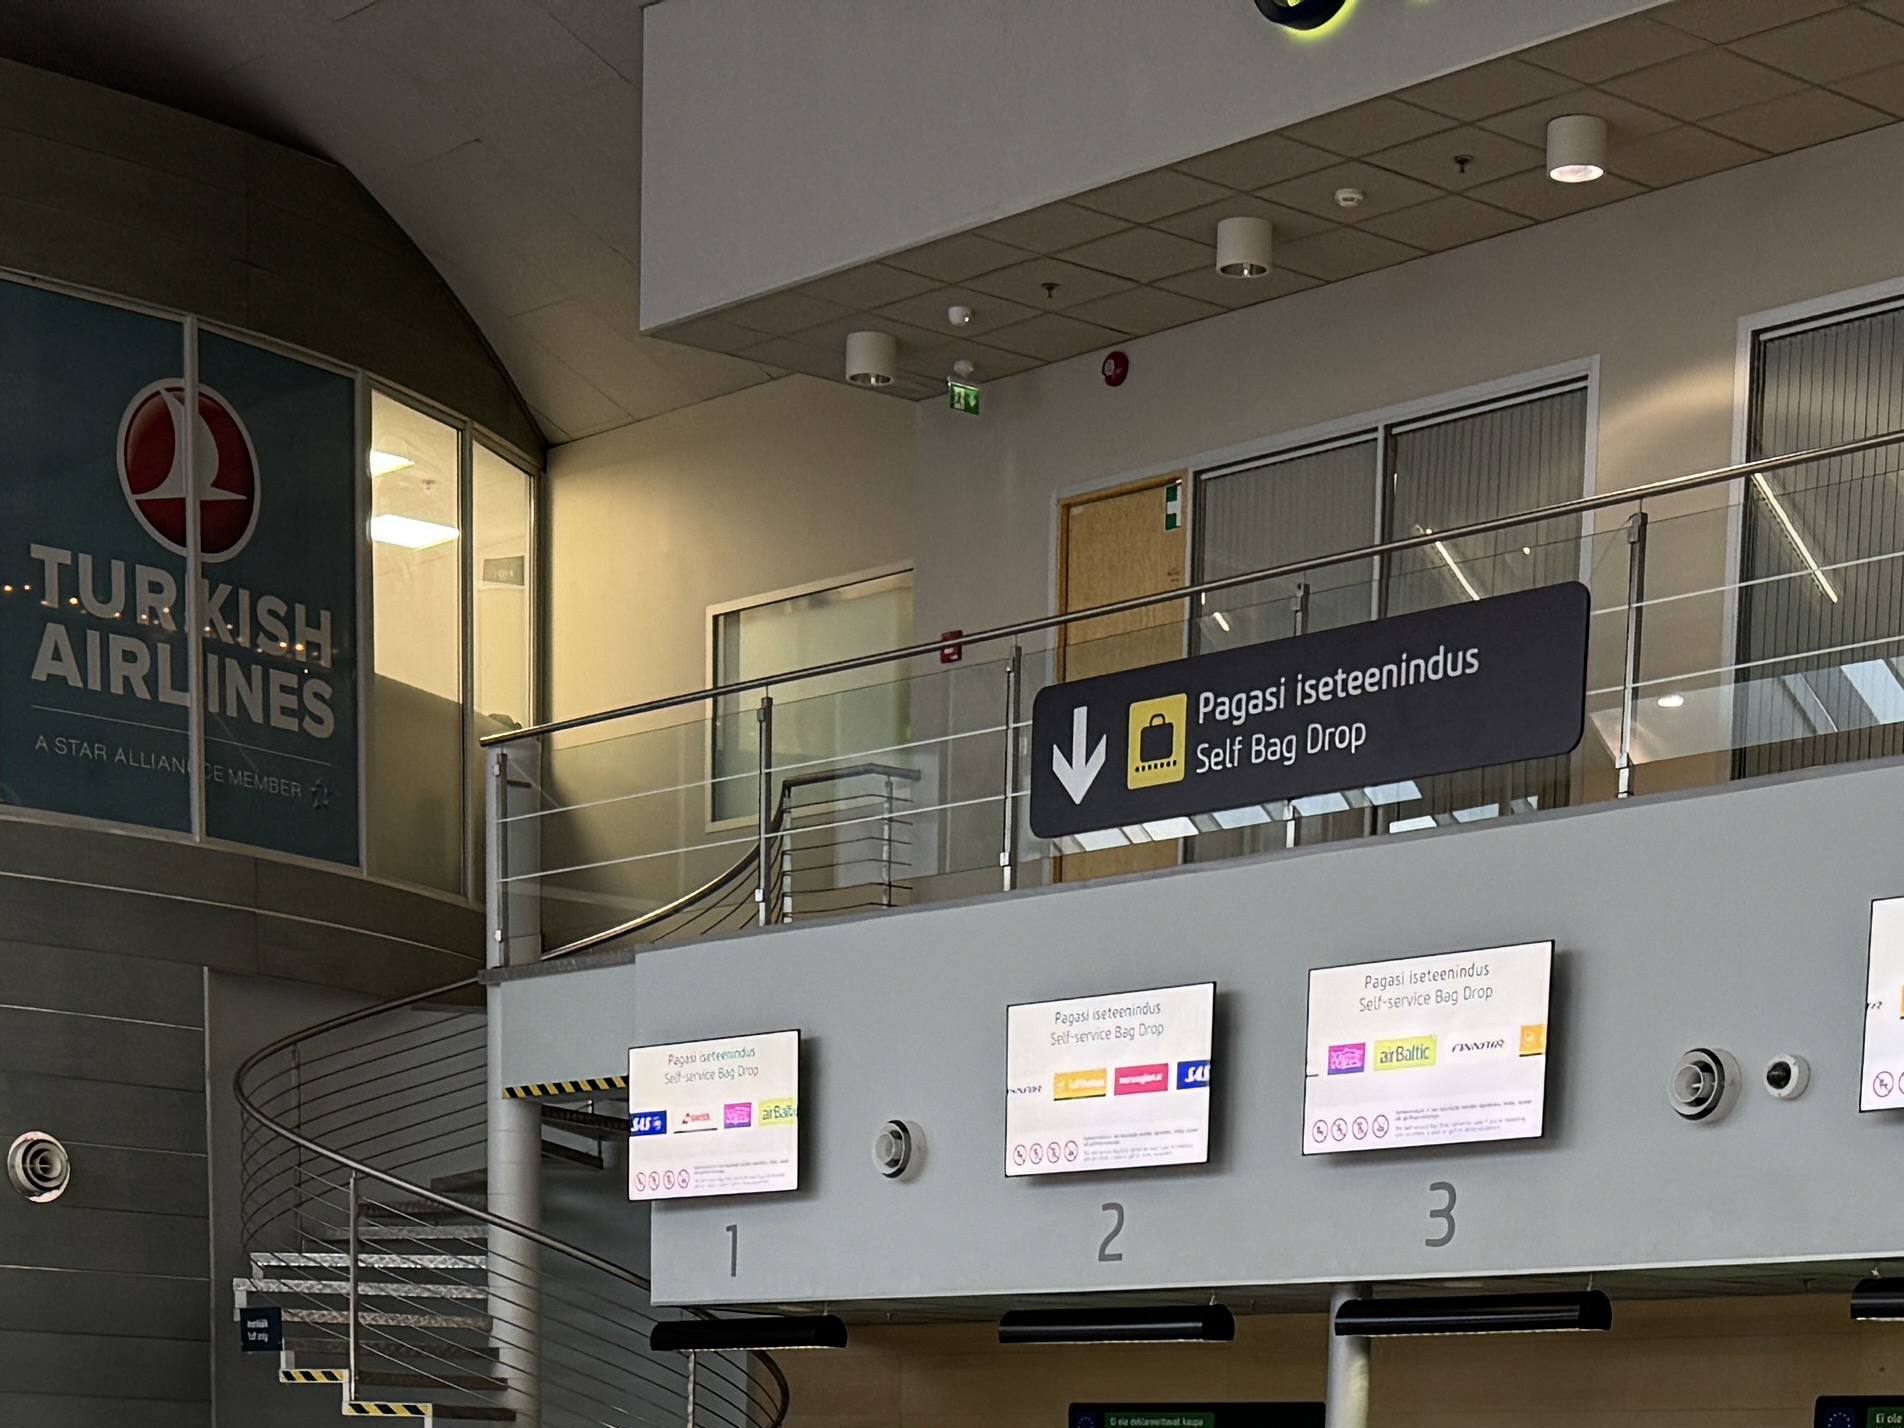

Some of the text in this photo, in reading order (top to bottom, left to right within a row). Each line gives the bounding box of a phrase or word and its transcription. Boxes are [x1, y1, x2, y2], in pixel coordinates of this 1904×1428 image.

[29, 543, 332, 669] TURKISH
[31, 622, 335, 739] AIRLINES
[1198, 646, 1480, 725] Pagasi iseteenindus
[35, 735, 48, 752] A
[55, 737, 107, 761] STAR
[228, 769, 303, 798] MEMBER
[1196, 721, 1367, 774] Self Bag Drop
[1359, 985, 1494, 1012] Self-service Bag Drop
[1364, 963, 1490, 991] Pagasi iseteenindus
[1050, 1022, 1165, 1046] Self-service Bag Drop
[1055, 1002, 1162, 1027] Pagasi iseteenindus
[718, 1068, 735, 1080] Bag
[738, 1065, 759, 1077] Drop
[1379, 1045, 1430, 1064] airBaltic
[1098, 1202, 1125, 1262] 2
[1424, 1181, 1457, 1247] 3
[725, 1224, 738, 1277] 1
